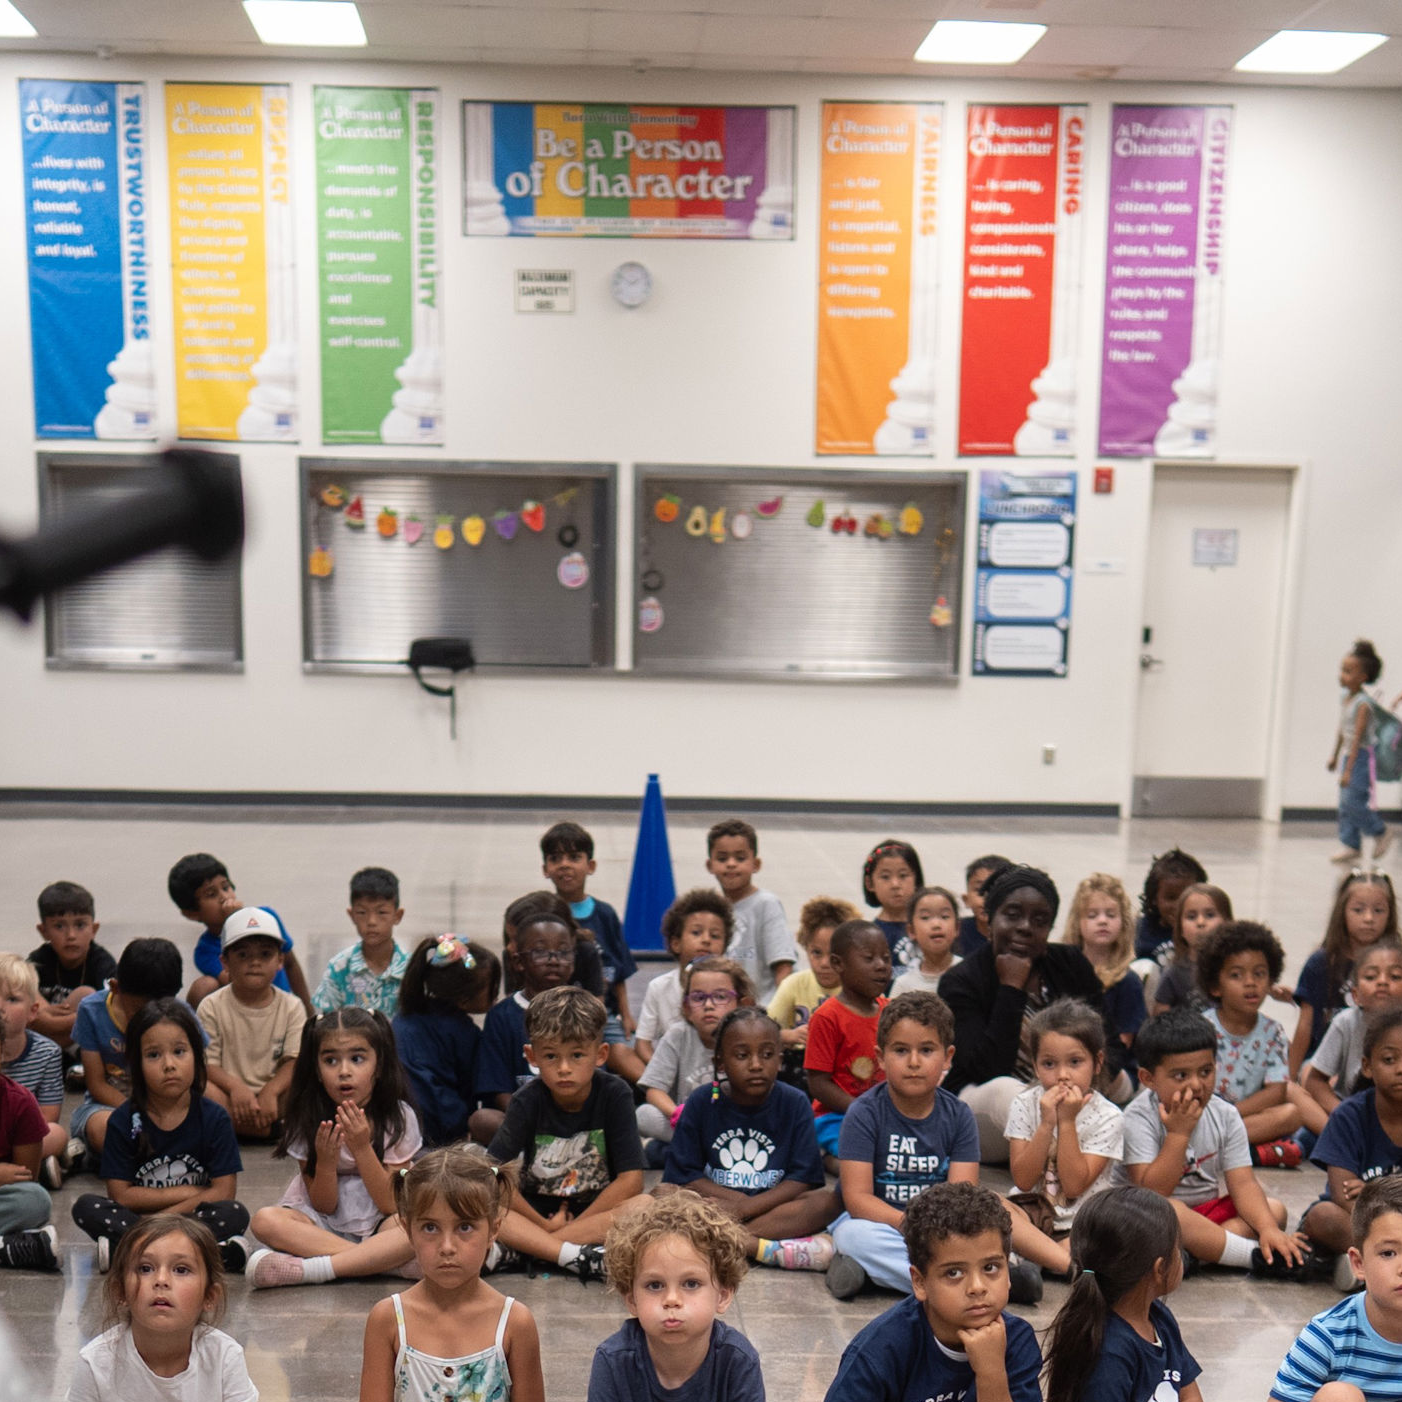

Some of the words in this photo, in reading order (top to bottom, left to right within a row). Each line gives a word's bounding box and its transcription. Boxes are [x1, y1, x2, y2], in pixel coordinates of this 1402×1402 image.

[42, 98, 91, 115] Person
[26, 112, 112, 133] Character
[319, 120, 405, 139] Character
[535, 128, 576, 159] Be
[586, 136, 606, 159] a
[612, 130, 723, 161] Person
[969, 137, 1054, 157] Character
[1115, 137, 1198, 158] Character
[920, 116, 940, 237] FAIRNESS
[1063, 116, 1084, 216] CARING
[505, 162, 544, 197] of
[556, 161, 753, 200] Character
[416, 101, 436, 309] RESPONSIBILITY
[1205, 119, 1228, 275] CITIZENSHIP
[123, 94, 149, 341] TRUSTWORTHINESS
[712, 1128, 745, 1151] TERRA
[749, 1128, 776, 1155] VISTA
[889, 1134, 917, 1155] EAT
[135, 1155, 171, 1180] TERRA
[886, 1154, 939, 1174] SLEEP
